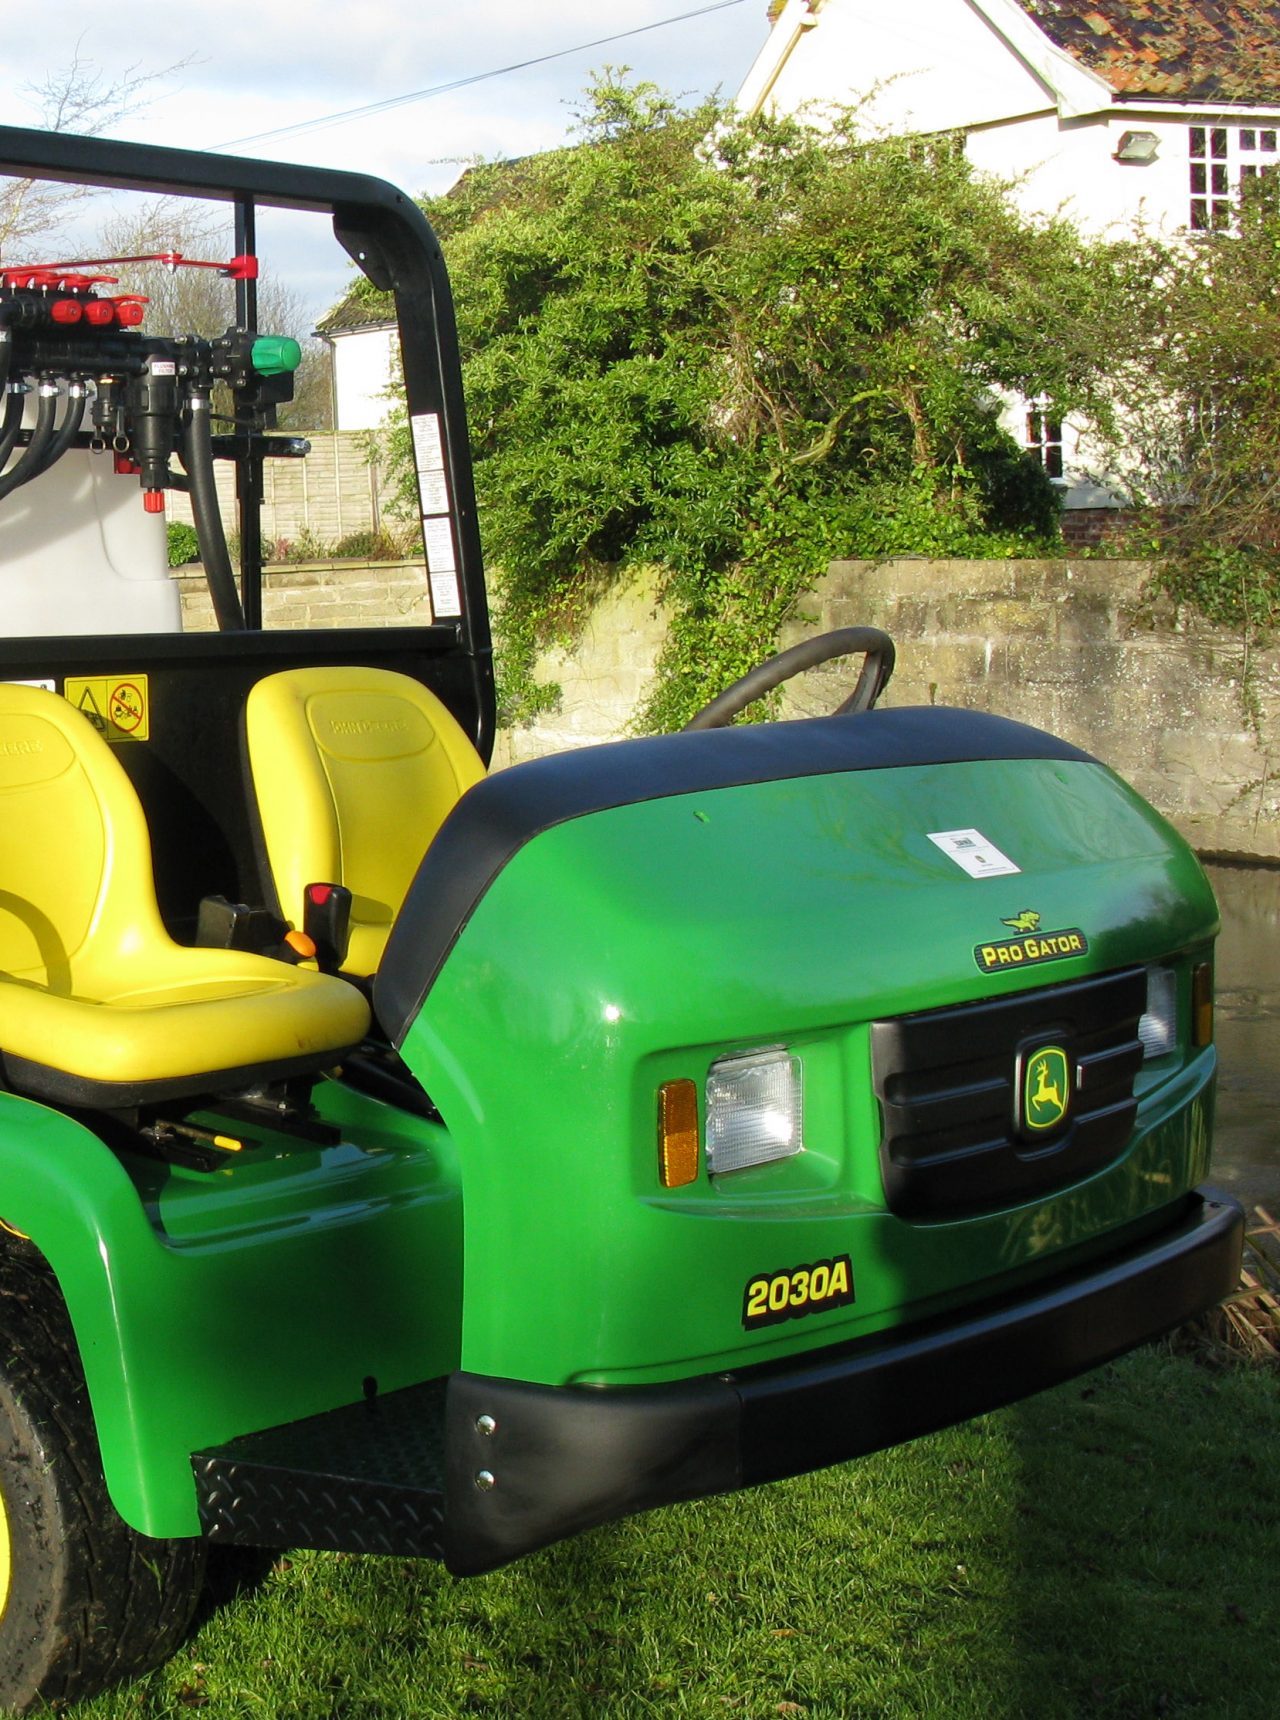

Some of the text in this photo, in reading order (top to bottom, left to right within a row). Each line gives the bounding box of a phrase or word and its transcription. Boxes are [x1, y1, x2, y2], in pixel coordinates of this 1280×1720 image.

[981, 934, 1082, 967] PRO GATOR
[747, 1261, 848, 1317] 2030A
